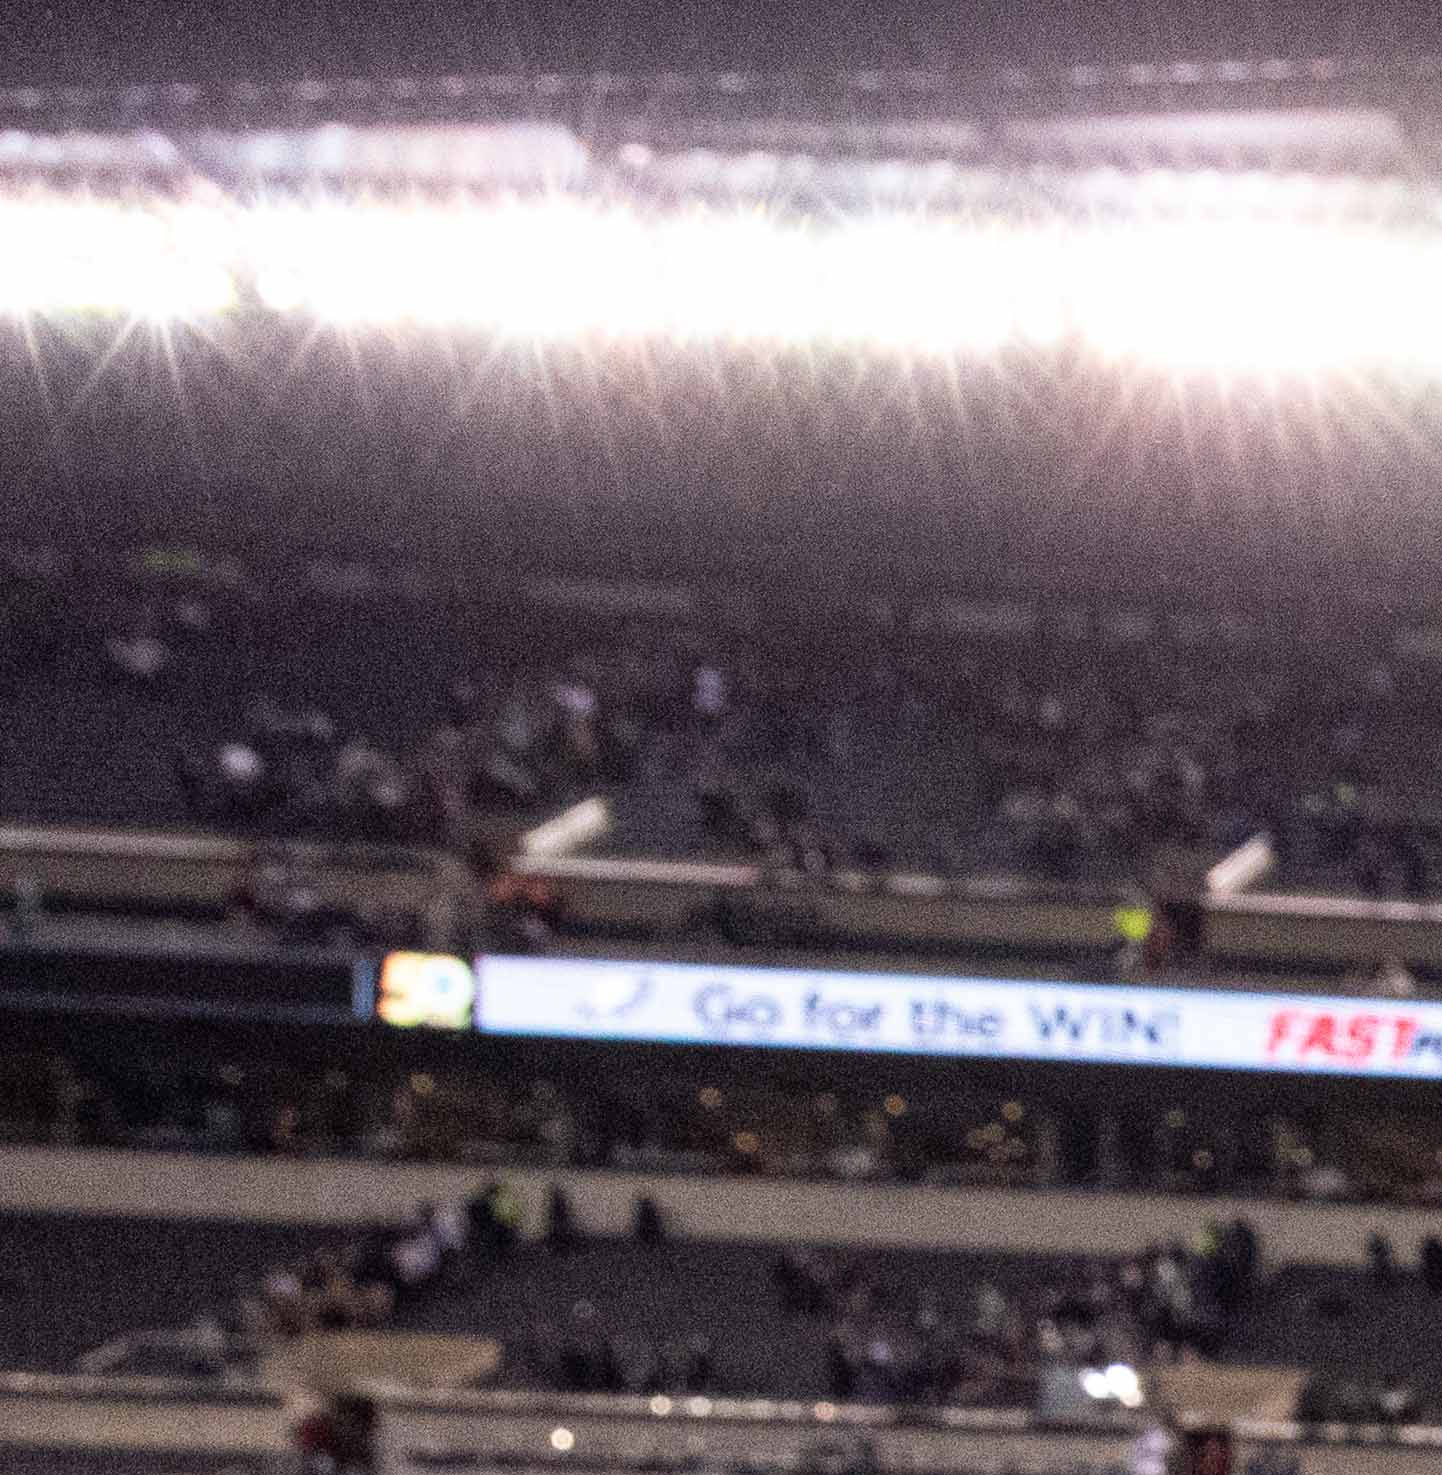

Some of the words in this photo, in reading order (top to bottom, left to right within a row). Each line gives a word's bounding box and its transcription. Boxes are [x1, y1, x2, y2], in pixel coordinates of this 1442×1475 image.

[692, 982, 778, 1034] Go
[803, 990, 880, 1031] for
[909, 998, 1003, 1039] the
